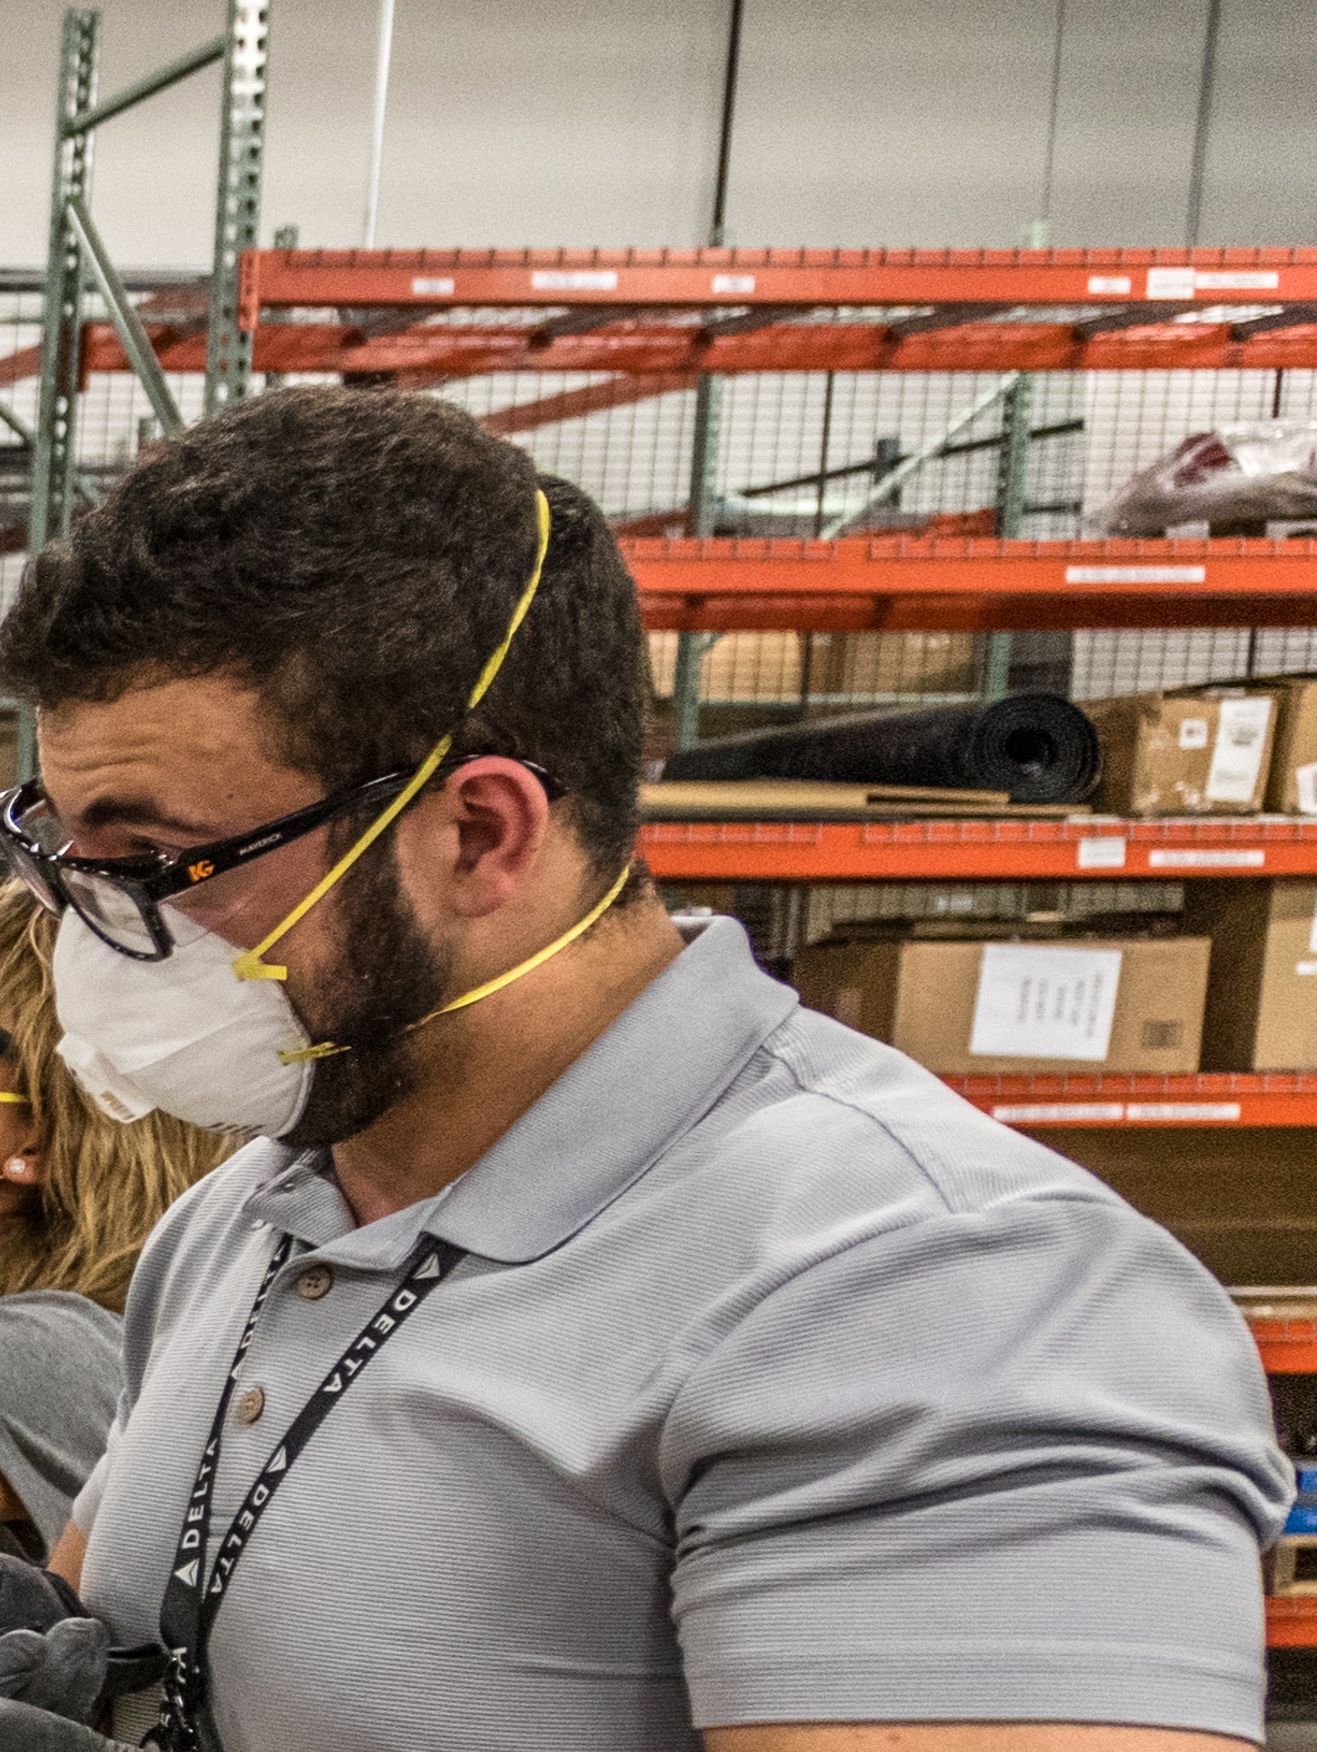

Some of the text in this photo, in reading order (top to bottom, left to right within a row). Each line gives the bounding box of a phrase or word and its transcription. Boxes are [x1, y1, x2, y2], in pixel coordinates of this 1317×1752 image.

[323, 1289, 418, 1393] DELTA
[181, 1438, 218, 1549] DELTA
[210, 1483, 270, 1594] DELTA
